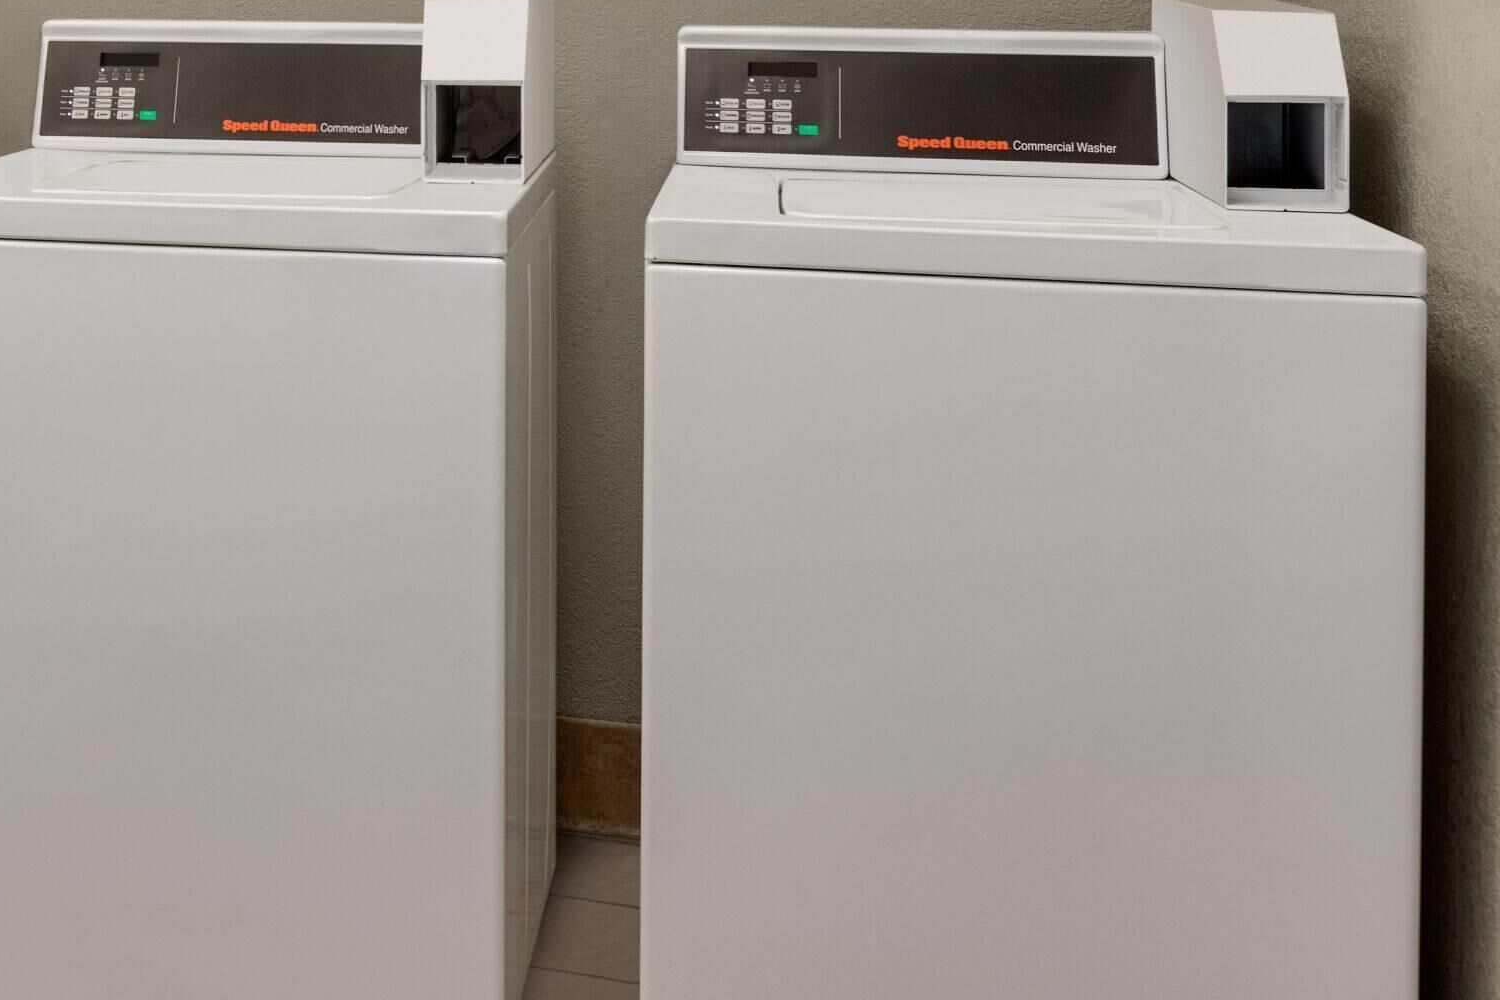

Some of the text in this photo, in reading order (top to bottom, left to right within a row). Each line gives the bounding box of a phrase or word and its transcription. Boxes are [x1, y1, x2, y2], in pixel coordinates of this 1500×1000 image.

[222, 119, 409, 134] Speed Queen Commercial Washer
[897, 135, 1117, 154] Speed Queen Commercial Washer
